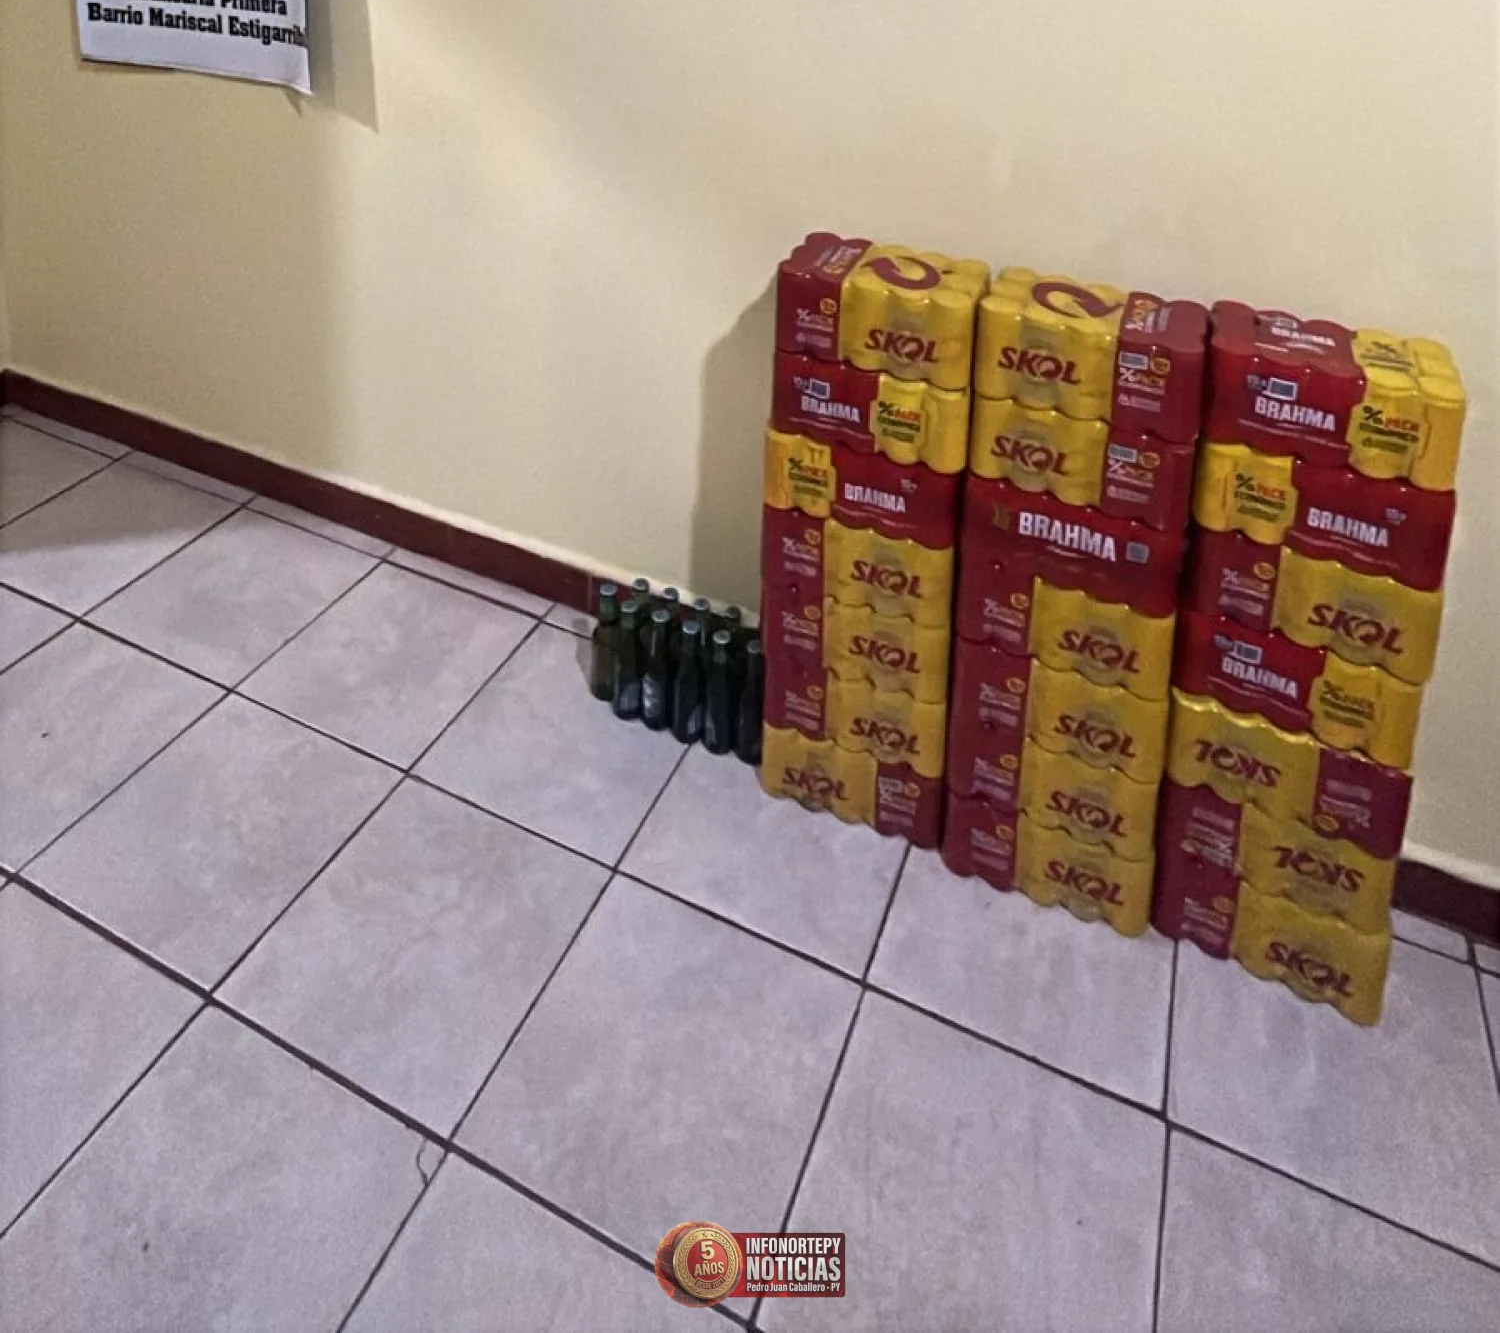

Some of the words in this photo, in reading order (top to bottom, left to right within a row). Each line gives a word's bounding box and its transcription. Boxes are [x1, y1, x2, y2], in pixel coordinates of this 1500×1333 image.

[87, 2, 143, 26] Barrio
[150, 8, 222, 34] Mariscal
[865, 329, 940, 363] SKOL
[997, 346, 1081, 384] SKOL
[801, 395, 860, 423] BRAHMA
[1255, 396, 1336, 431] BRAHMA
[990, 435, 1071, 476] SKOL
[844, 482, 906, 513] BRAHMA
[1018, 511, 1116, 562] BRAHMA
[1307, 507, 1388, 547] BRAHMA
[852, 560, 923, 598] SKOL
[1307, 604, 1403, 654] SKOL
[848, 635, 920, 674] SKOL
[1058, 629, 1141, 674] SKOL
[1222, 657, 1298, 699] BRAHMA
[851, 718, 920, 755] SKOL
[1054, 714, 1136, 759] SKOL
[782, 767, 848, 801] SKOL
[1045, 790, 1127, 838] SKOL
[1044, 860, 1124, 907] SKOL
[1265, 941, 1353, 998] SKOL
